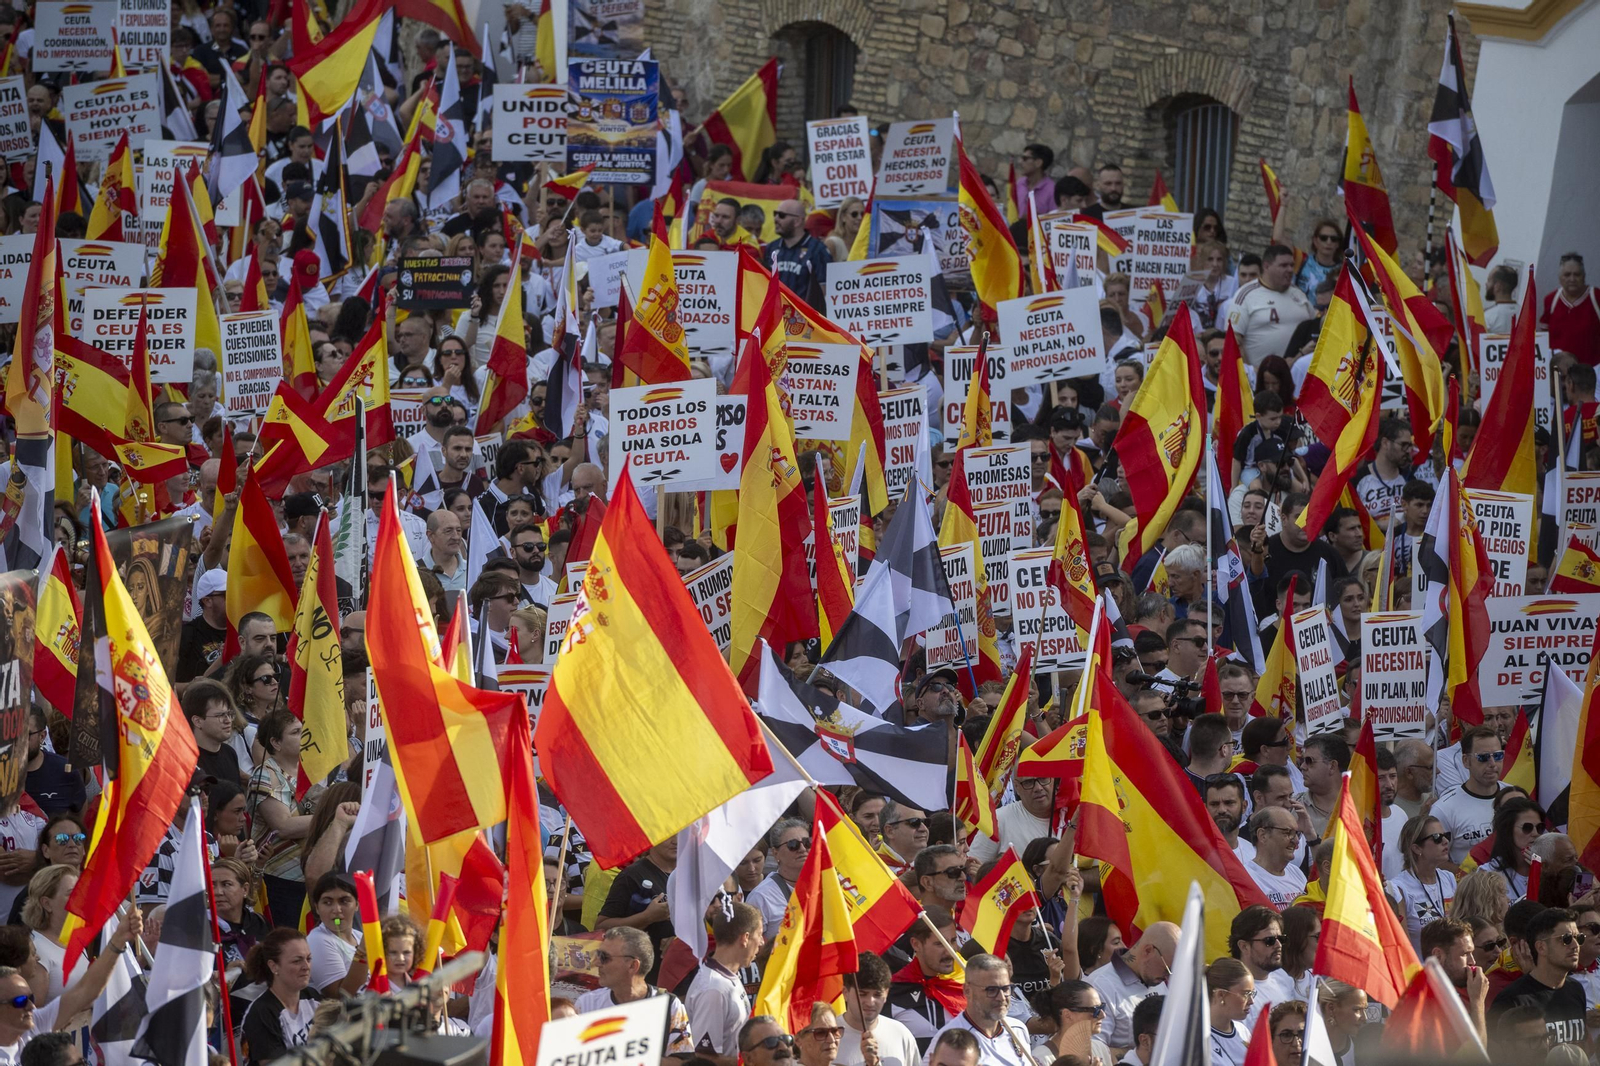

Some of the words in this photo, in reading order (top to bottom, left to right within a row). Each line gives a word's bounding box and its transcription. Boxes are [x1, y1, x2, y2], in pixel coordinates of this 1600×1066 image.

[64, 16, 91, 25] CEUTA
[120, 14, 124, 26] Y
[58, 27, 98, 36] NECESITA
[120, 31, 167, 45] AGILIDAD
[36, 50, 48, 59] NO
[125, 48, 132, 62] Y
[138, 48, 163, 62] LEY
[580, 61, 646, 75] CEUTA
[580, 76, 647, 90] MELILLA
[74, 94, 125, 109] CEUTA
[130, 90, 149, 100] ES
[70, 100, 156, 121] ESPAÑOLA,
[15, 121, 28, 133] NO
[90, 116, 122, 129] HOY
[128, 114, 137, 123] Y
[817, 123, 860, 138] GRACIAS
[508, 133, 567, 145] CEUT
[815, 135, 864, 152] ESPAÑA
[903, 134, 936, 146] CEUTA
[573, 153, 602, 161] CEUTA
[612, 154, 651, 162] MELILLA
[815, 151, 834, 164] POR
[837, 149, 866, 162] ESTAR
[893, 146, 942, 159] NECESITA
[147, 157, 168, 167] LAS
[885, 159, 929, 171] HECHOS,
[931, 157, 947, 167] NO
[155, 170, 172, 181] NO
[826, 164, 858, 180] CON
[885, 170, 943, 183] DISCURSOS
[151, 183, 174, 193] HAC
[820, 180, 868, 198] CEUTA
[1157, 219, 1173, 230] LAS
[945, 229, 957, 241] NO
[1137, 229, 1191, 244] PROMESAS
[1137, 244, 1149, 255] NO
[1152, 245, 1190, 258] BASTAN:
[68, 258, 116, 271] CEUTA
[404, 258, 439, 268] NUESTRAS
[777, 261, 802, 275] EUTA
[1135, 261, 1161, 274] HACEN
[1164, 261, 1187, 275] FALTA
[99, 273, 131, 286] UNA
[836, 279, 860, 292] CON
[864, 273, 922, 289] ACIERTOS
[403, 289, 414, 300] SU
[831, 295, 841, 306] Y
[842, 287, 927, 305] DESACIERTOS,
[834, 306, 870, 319] VIVAS
[874, 301, 925, 316] SIEMPRE
[1026, 309, 1064, 326] CEUTA
[162, 323, 183, 334] ES
[227, 323, 238, 336] SE
[240, 319, 273, 334] PUEDEN
[848, 322, 864, 332] AL
[867, 317, 913, 331] FRENTE
[1020, 322, 1075, 341] NECESITA
[226, 334, 277, 351] CUESTIONAR
[1013, 345, 1029, 357] UN
[1032, 338, 1065, 354] PLAN,
[1068, 334, 1085, 347] NO
[228, 348, 277, 365] DECISIONES
[1010, 347, 1096, 372] MPROVISACIÓN
[226, 371, 234, 382] NO
[235, 371, 242, 382] EL
[952, 357, 1006, 381] UNOS
[239, 381, 270, 394] GRACIAS
[789, 378, 837, 391] ASTAN:
[228, 396, 253, 411] JUAN
[799, 394, 840, 407] FALTA
[617, 405, 671, 421] TODOS
[676, 400, 707, 415] LOS
[627, 417, 697, 436] BARRIOS
[622, 438, 656, 452] UNA
[660, 433, 703, 447] SOLA
[633, 450, 690, 467] CEUTA.
[891, 444, 914, 465] SIN
[989, 453, 1009, 467] LAS
[968, 465, 1030, 486] PROMESAS
[969, 488, 984, 503] NO
[986, 482, 1031, 502] BASTAN:
[1365, 484, 1403, 502] CEUT
[1475, 503, 1515, 520] CEUTA
[1566, 508, 1597, 523] CEUTA
[1490, 520, 1521, 539] PIDE
[982, 537, 1010, 557] OLVIDA
[1016, 592, 1035, 610] NO
[313, 606, 332, 640] NO
[1490, 619, 1539, 634] JUAN
[945, 628, 959, 643] NO
[1299, 623, 1326, 649] CEUTA
[1372, 626, 1417, 647] CEUTA
[1503, 635, 1593, 650] SIEMPRE
[1300, 655, 1310, 672] NO
[1366, 651, 1424, 673] NECESITA
[1504, 654, 1529, 668] AL
[1497, 672, 1522, 686] DE
[1304, 677, 1327, 705] FALLA
[1326, 673, 1337, 696] EL
[1365, 683, 1378, 700] UN
[1381, 681, 1409, 701] PLAN,
[1411, 681, 1425, 698] NO
[366, 738, 383, 762] UNA
[625, 1037, 650, 1059] ES
